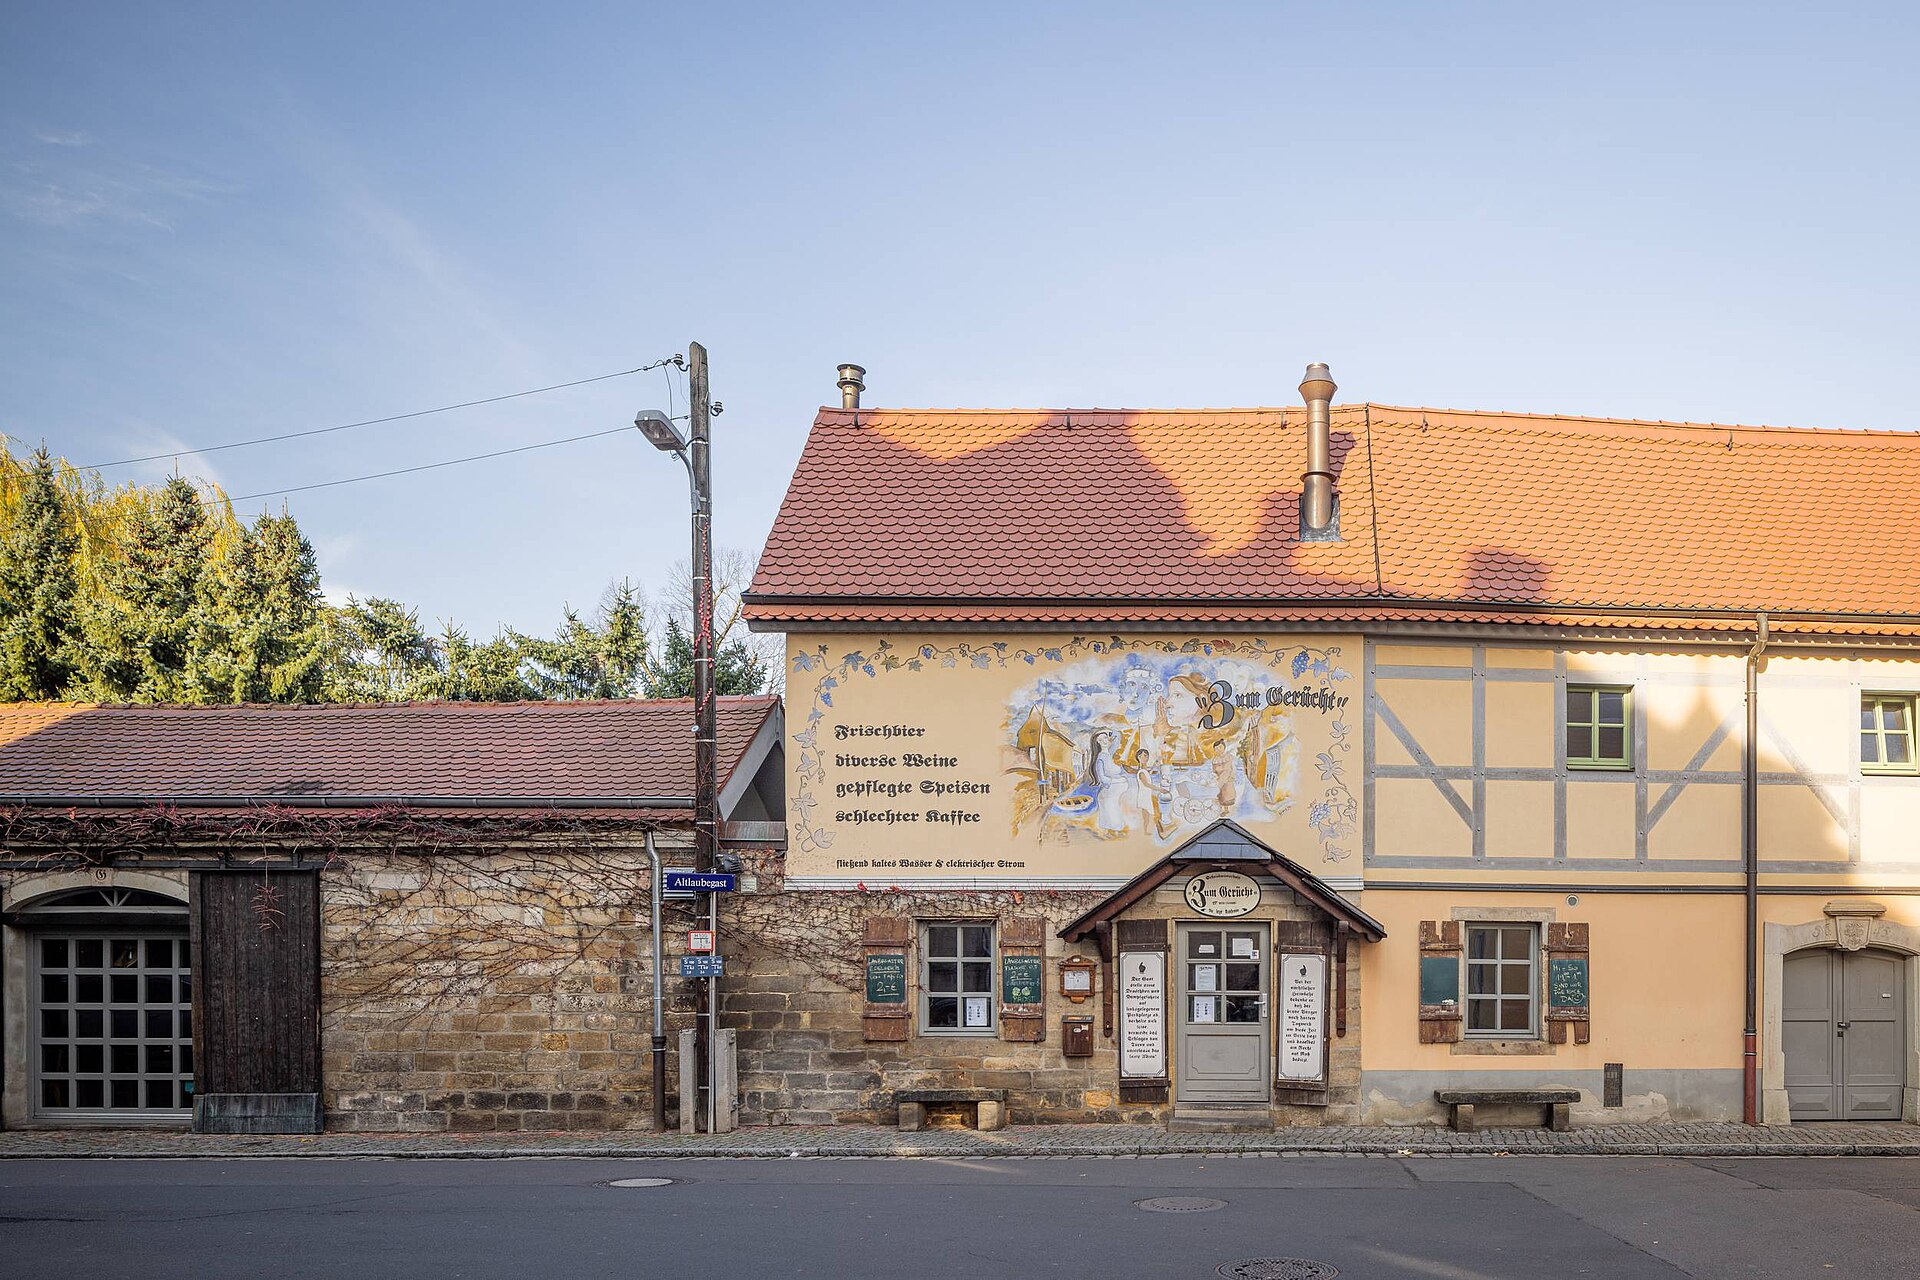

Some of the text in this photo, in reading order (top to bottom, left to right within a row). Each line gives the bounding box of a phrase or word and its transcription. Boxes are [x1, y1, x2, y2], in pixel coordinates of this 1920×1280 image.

[834, 724, 926, 741] Frischbier
[835, 753, 958, 768] diverse Weine
[835, 779, 991, 798] gepflegte Speisen
[835, 809, 981, 826] schlechter Kaffee
[871, 859, 897, 868] kaltes
[898, 859, 933, 868] Wasser
[935, 859, 944, 868] &
[945, 859, 995, 869] elektrischer
[997, 859, 1025, 868] Strom
[674, 878, 727, 889] Altlaubegast
[1190, 878, 1253, 908] Zum Gerücht
